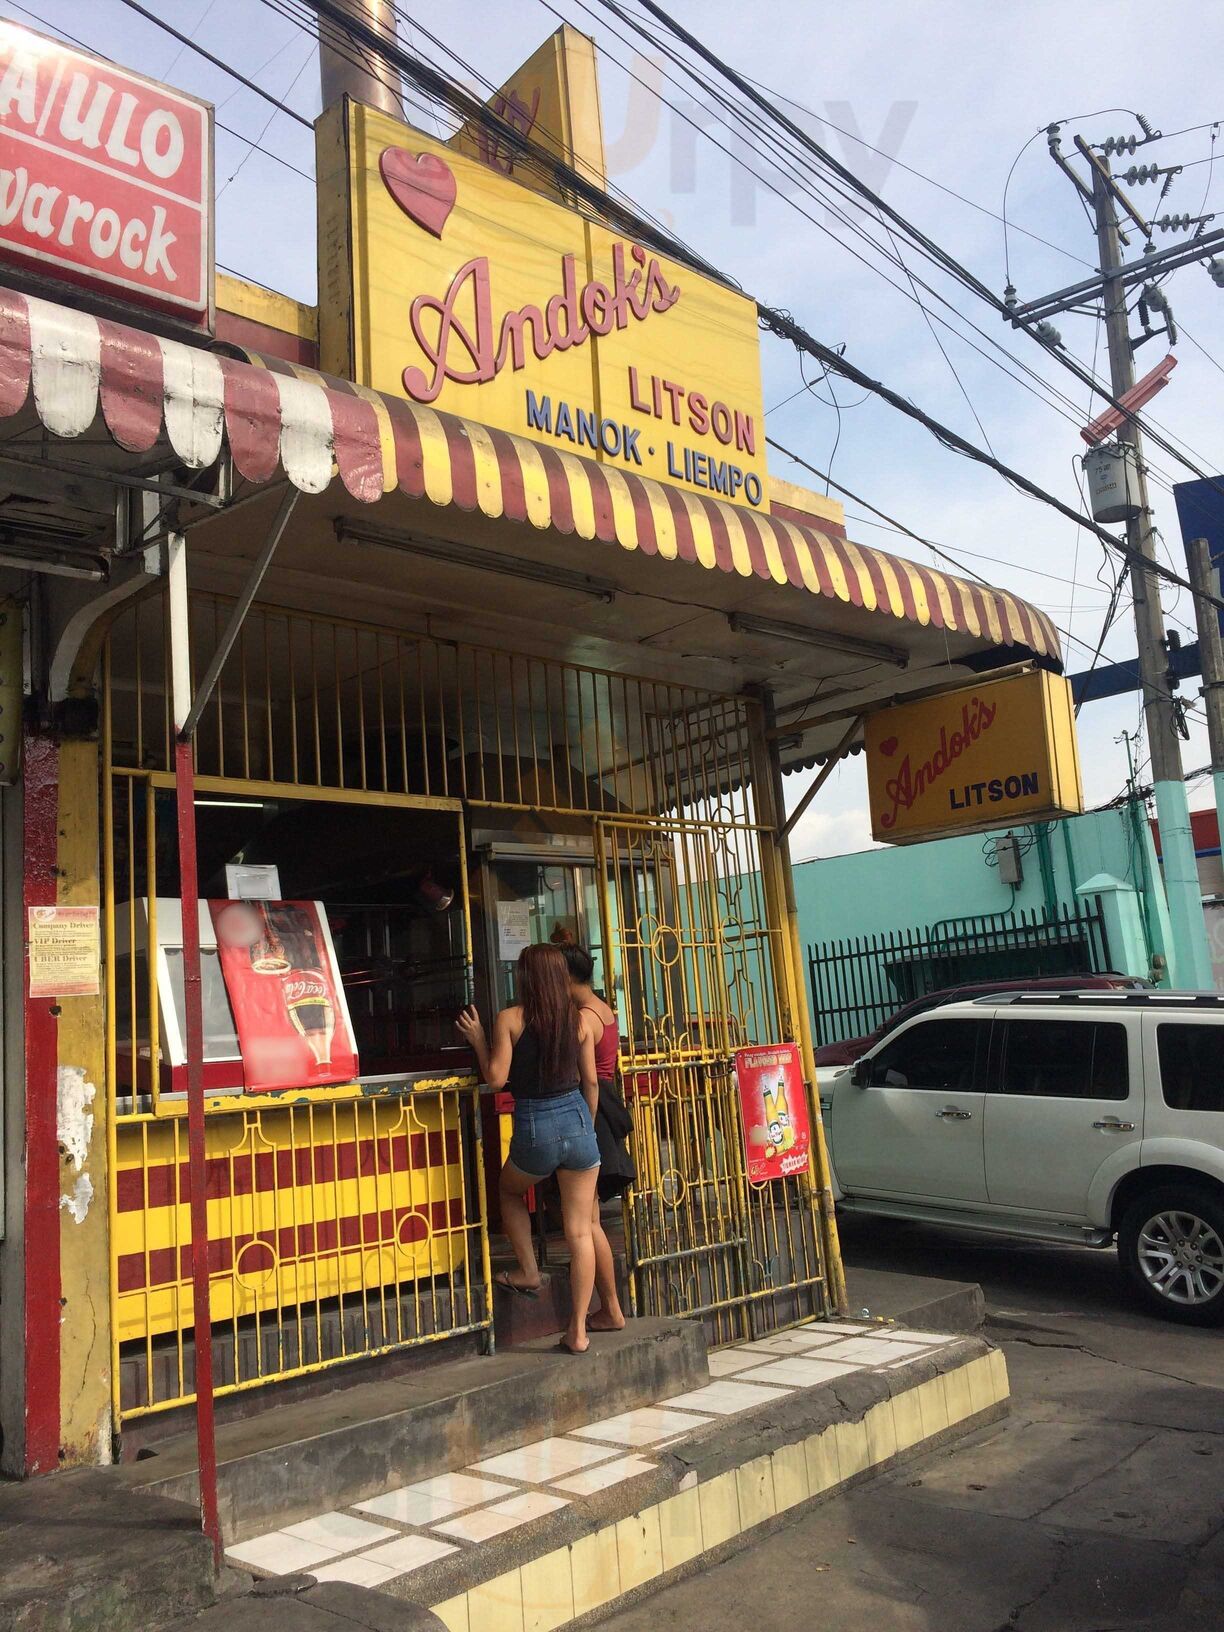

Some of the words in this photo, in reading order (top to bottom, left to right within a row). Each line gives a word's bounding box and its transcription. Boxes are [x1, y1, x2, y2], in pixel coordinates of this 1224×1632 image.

[401, 241, 681, 403] Andok's
[525, 389, 642, 466] MANOK
[666, 440, 763, 505] LIEMPO
[628, 366, 756, 457] LITSON
[880, 696, 997, 829] Andok's
[949, 772, 1039, 810] LITSON
[33, 922, 68, 930] Company
